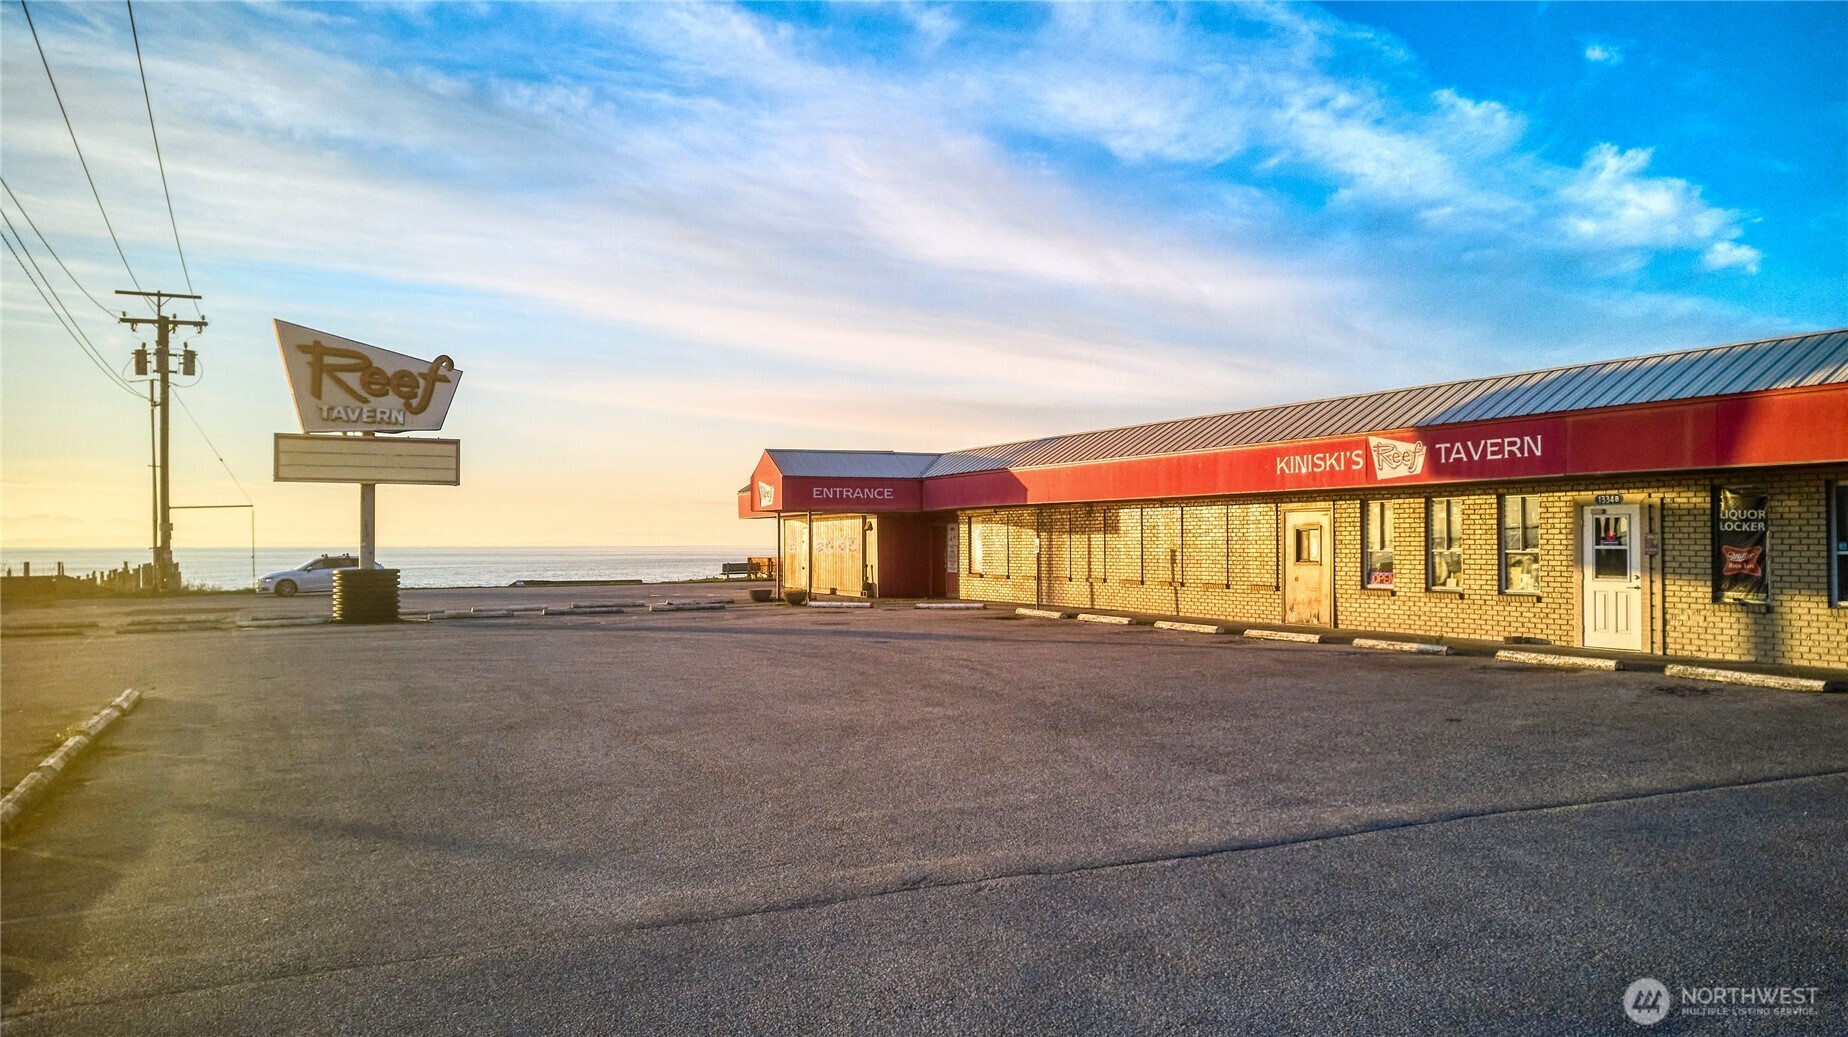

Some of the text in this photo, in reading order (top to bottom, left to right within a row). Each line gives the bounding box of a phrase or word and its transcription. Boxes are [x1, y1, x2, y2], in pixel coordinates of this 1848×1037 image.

[296, 340, 454, 415] Reef
[318, 404, 406, 425] TAVERN
[1276, 435, 1542, 475] KINISKI'S Reef TAVERN
[812, 487, 894, 499] ENTRANCE
[1720, 509, 1766, 520] LIQUOR
[1720, 521, 1766, 531] LOCKER
